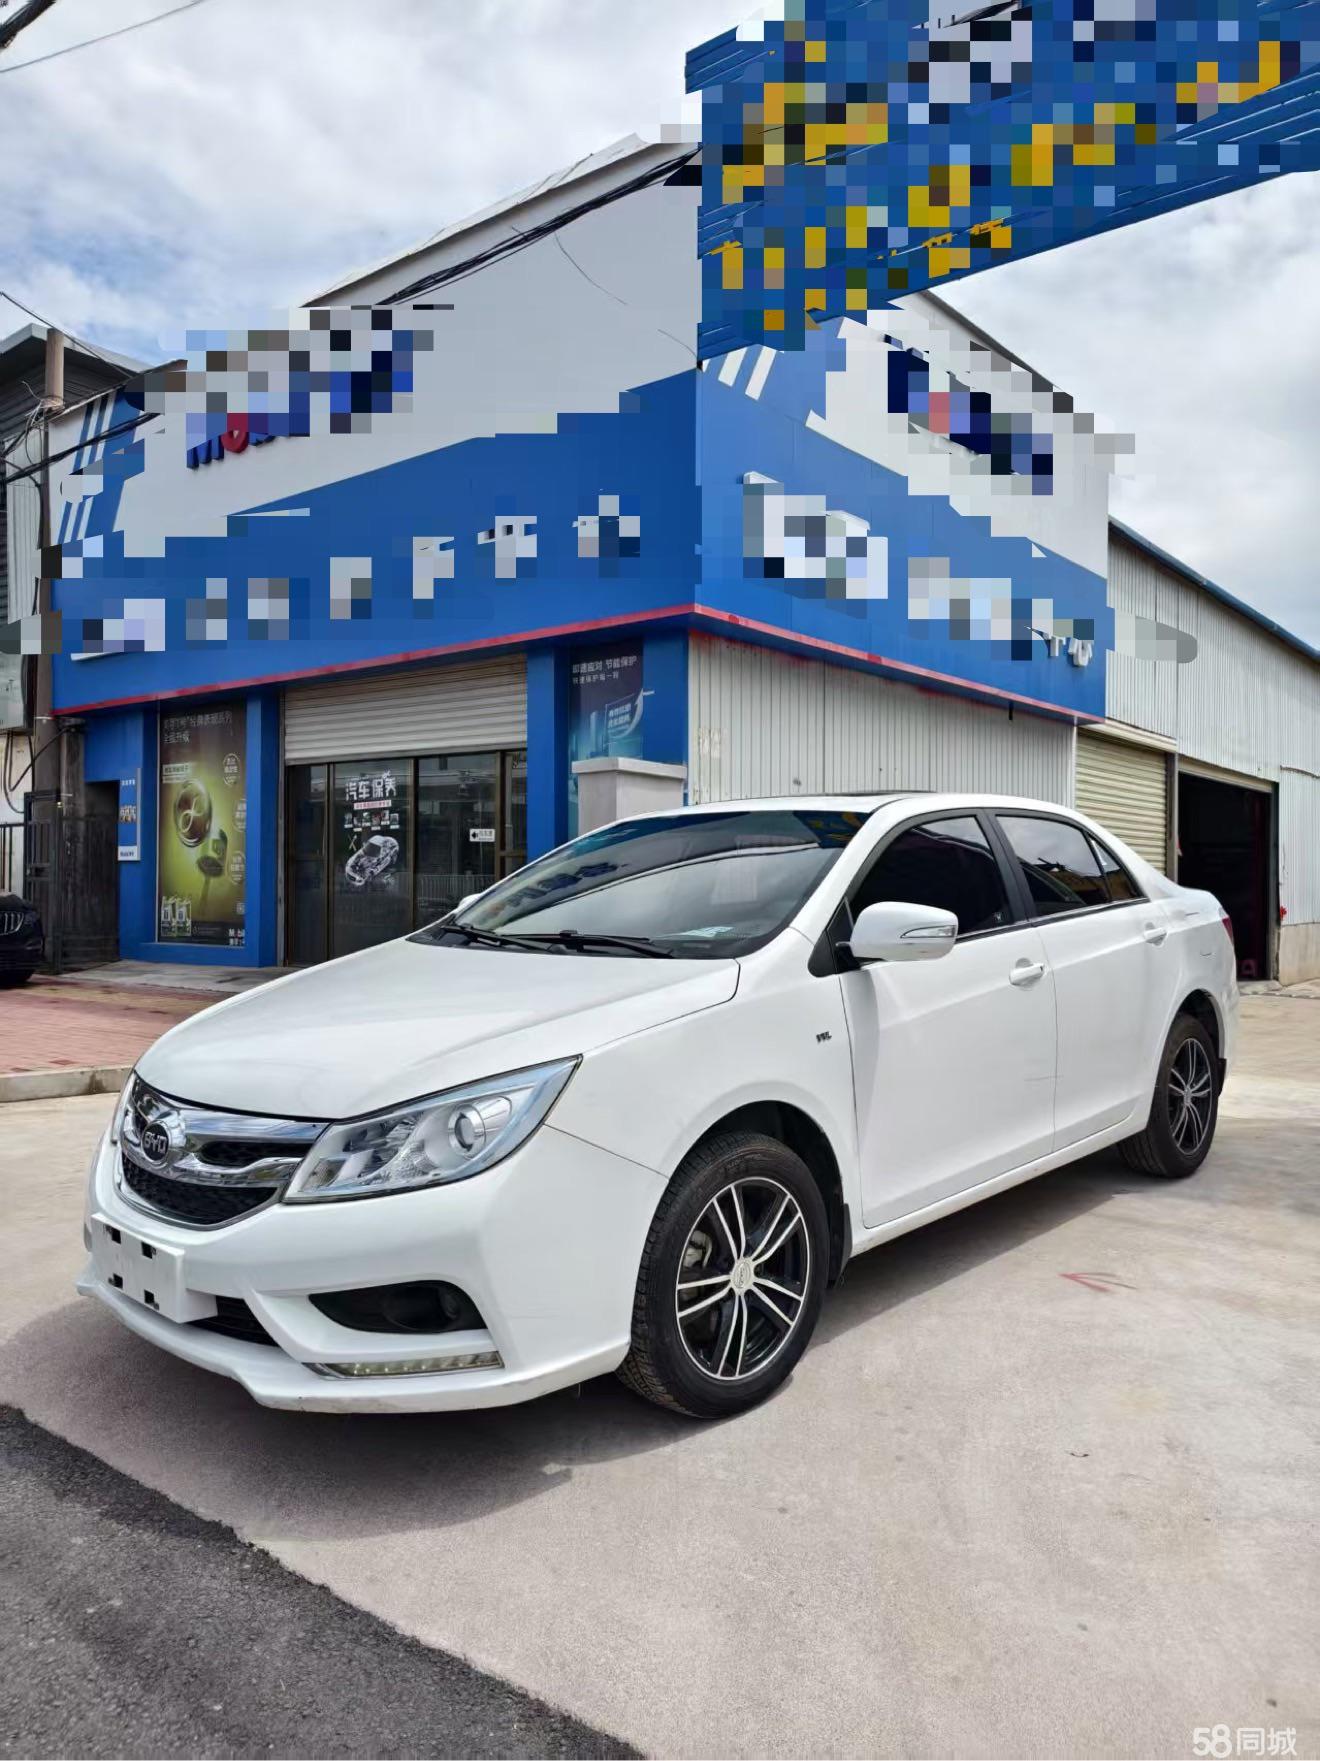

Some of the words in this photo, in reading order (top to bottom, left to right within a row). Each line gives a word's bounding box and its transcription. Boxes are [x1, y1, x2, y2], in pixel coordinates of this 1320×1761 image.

[345, 771, 397, 801] 汽车保养
[144, 1131, 168, 1154] BYD
